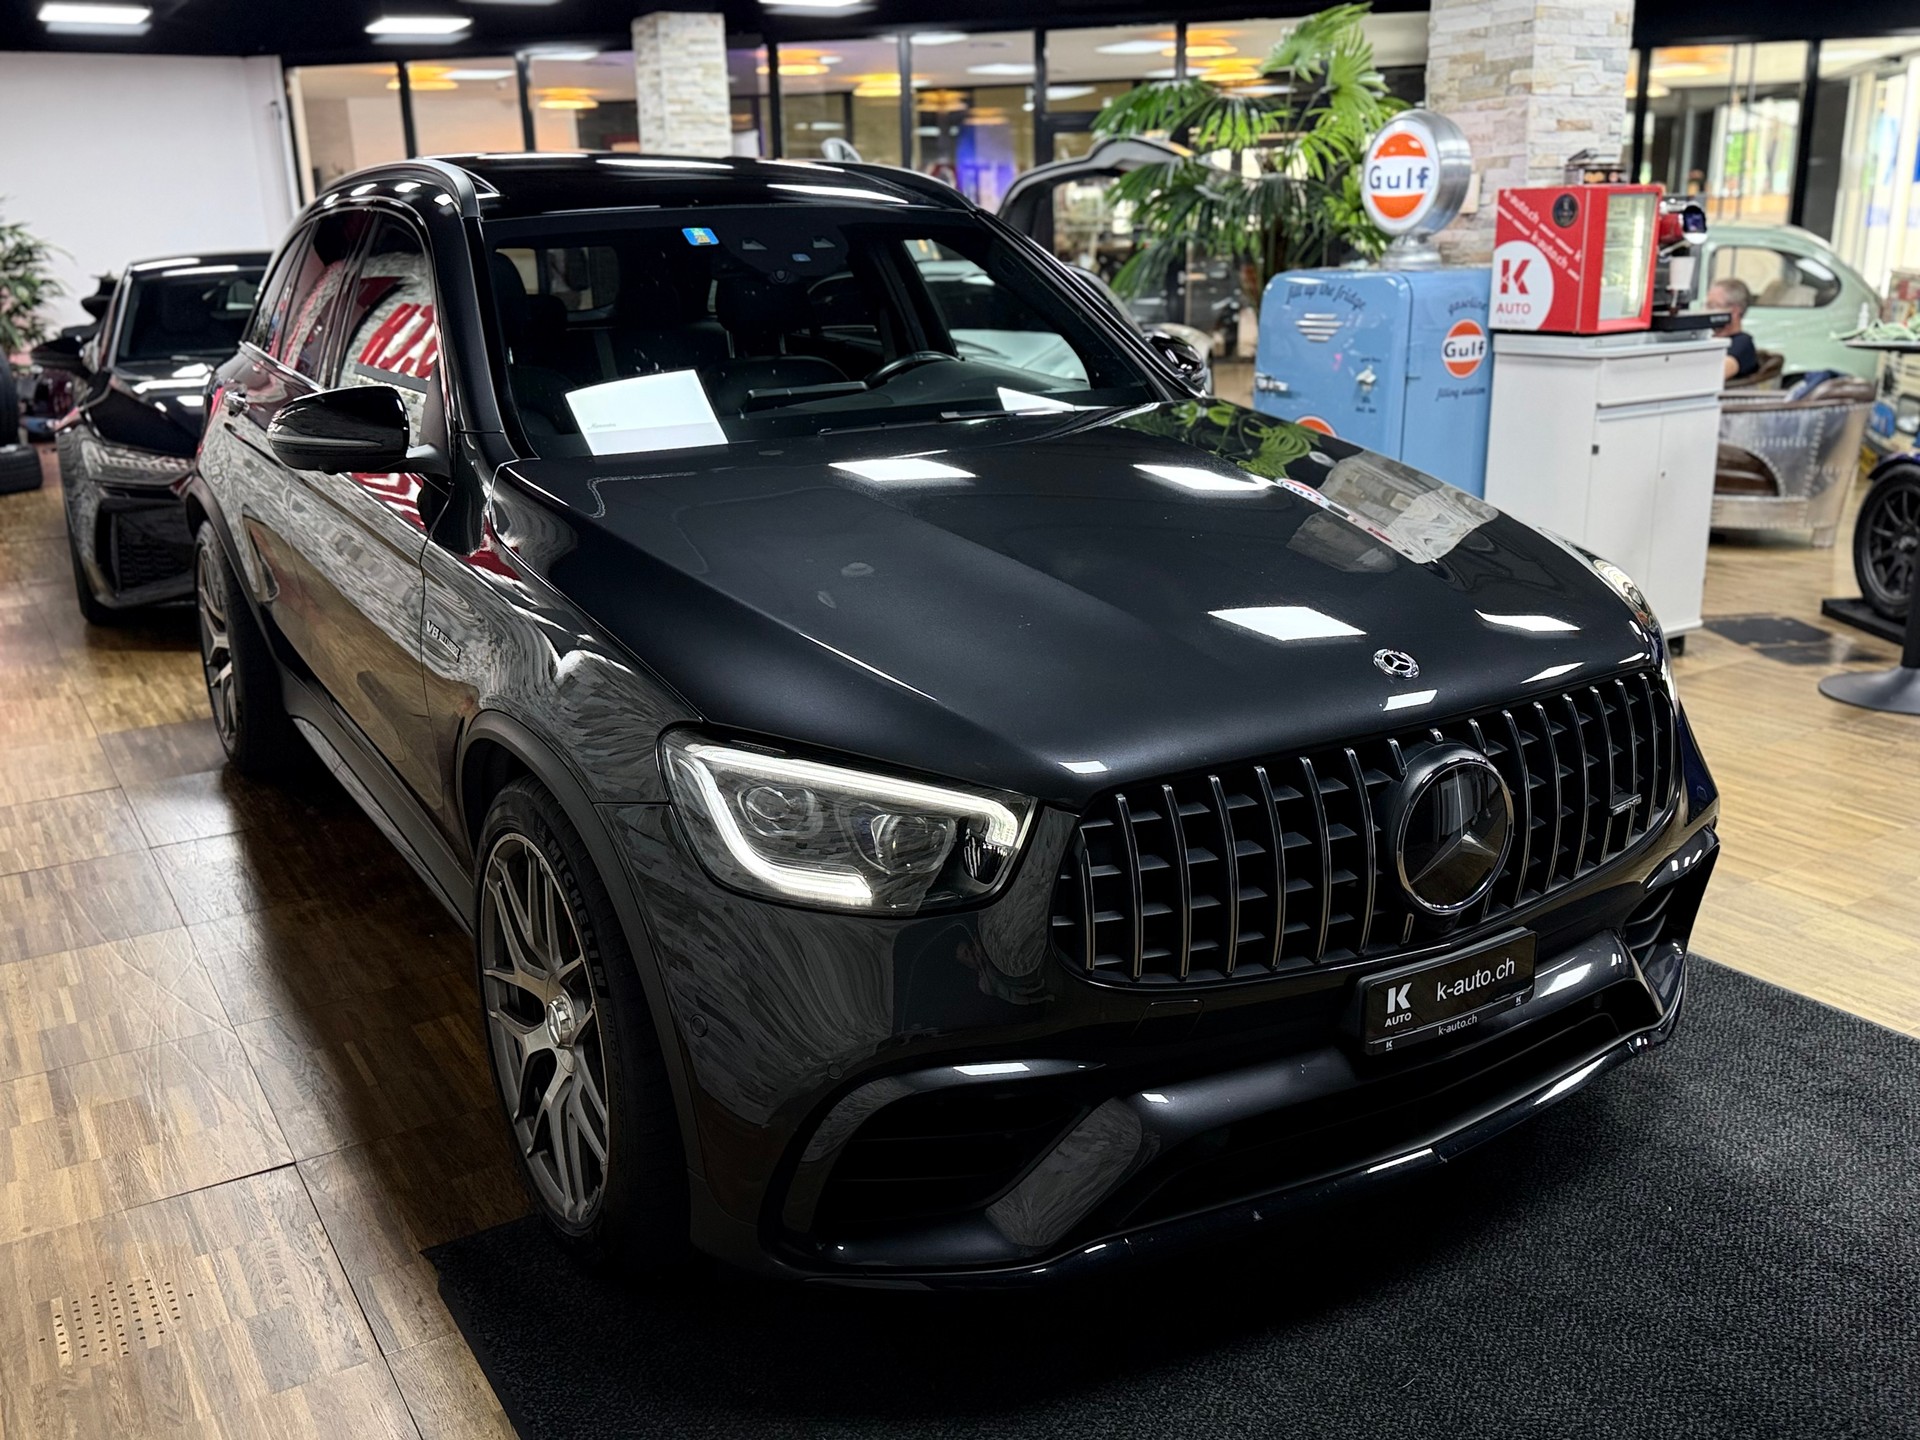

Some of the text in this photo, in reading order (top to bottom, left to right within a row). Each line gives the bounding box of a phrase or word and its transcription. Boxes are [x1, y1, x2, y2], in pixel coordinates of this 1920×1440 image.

[1369, 165, 1430, 189] Gulf
[1500, 259, 1531, 294] K
[1496, 303, 1531, 314] AUTO
[1444, 341, 1485, 358] Gulf
[547, 838, 607, 987] MICHELIN
[1436, 957, 1515, 1002] k-auto.ch
[1386, 982, 1412, 1014] K
[1384, 1012, 1412, 1028] AUTO
[1438, 1014, 1478, 1036] k-auto.ch
